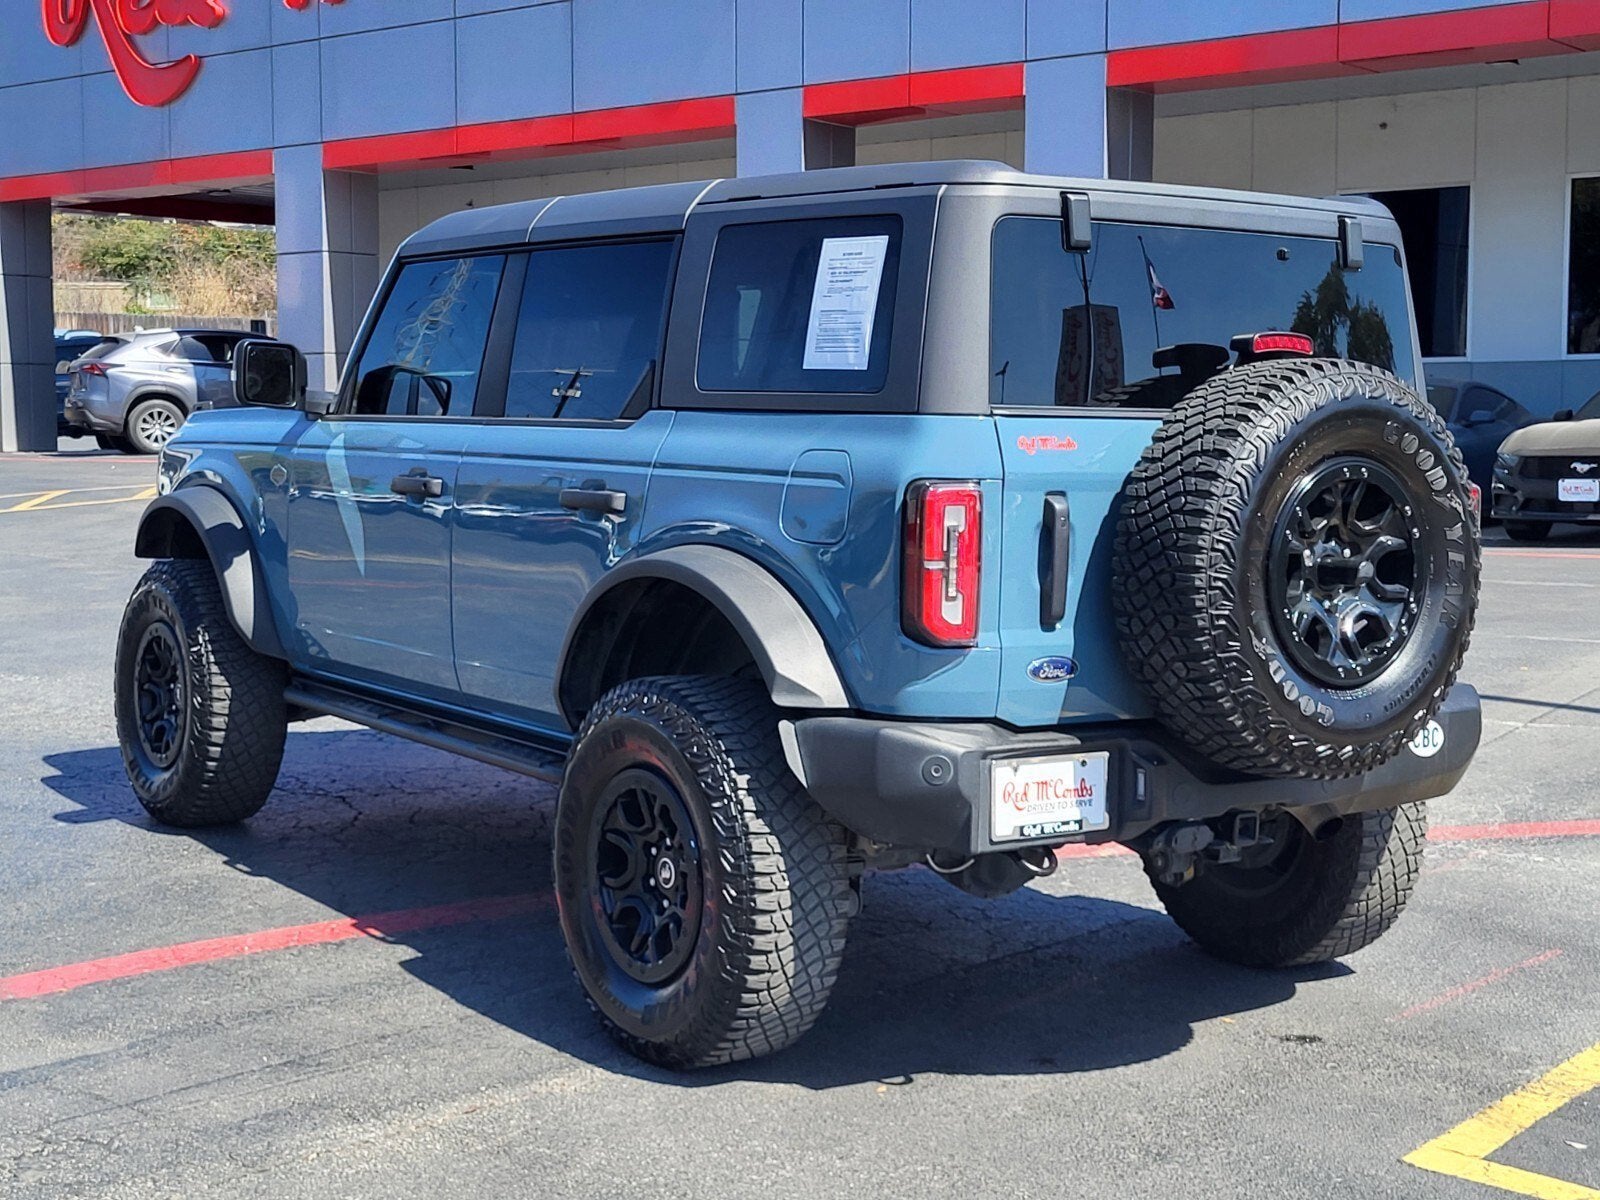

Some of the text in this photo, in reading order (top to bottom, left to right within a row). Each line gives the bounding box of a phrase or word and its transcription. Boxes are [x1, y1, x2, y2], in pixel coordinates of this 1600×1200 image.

[1039, 662, 1068, 678] Ford
[1003, 777, 1093, 811] Red McCombs
[1027, 798, 1094, 813] DRIVEN TO SERVE
